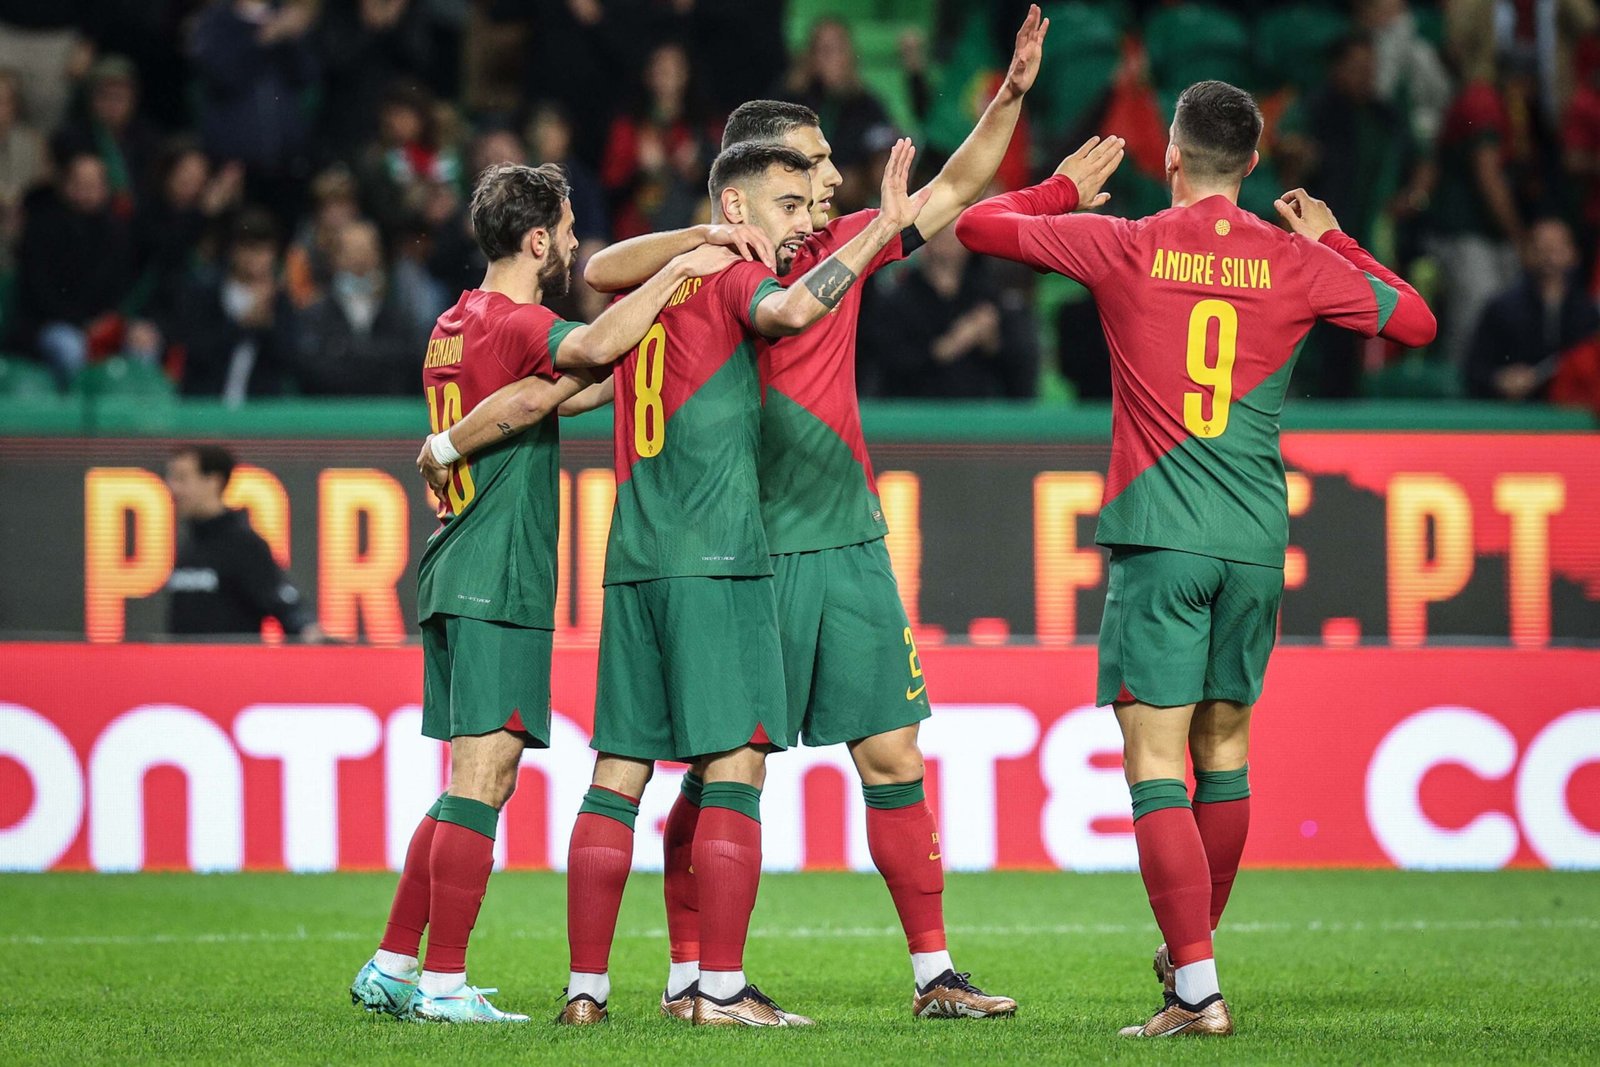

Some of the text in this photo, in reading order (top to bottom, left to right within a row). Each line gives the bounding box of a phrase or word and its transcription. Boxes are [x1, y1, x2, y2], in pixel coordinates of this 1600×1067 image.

[1150, 248, 1272, 289] ANDRÉ SILVA
[635, 322, 667, 458] 8
[1183, 299, 1238, 439] 9
[904, 627, 922, 678] 2
